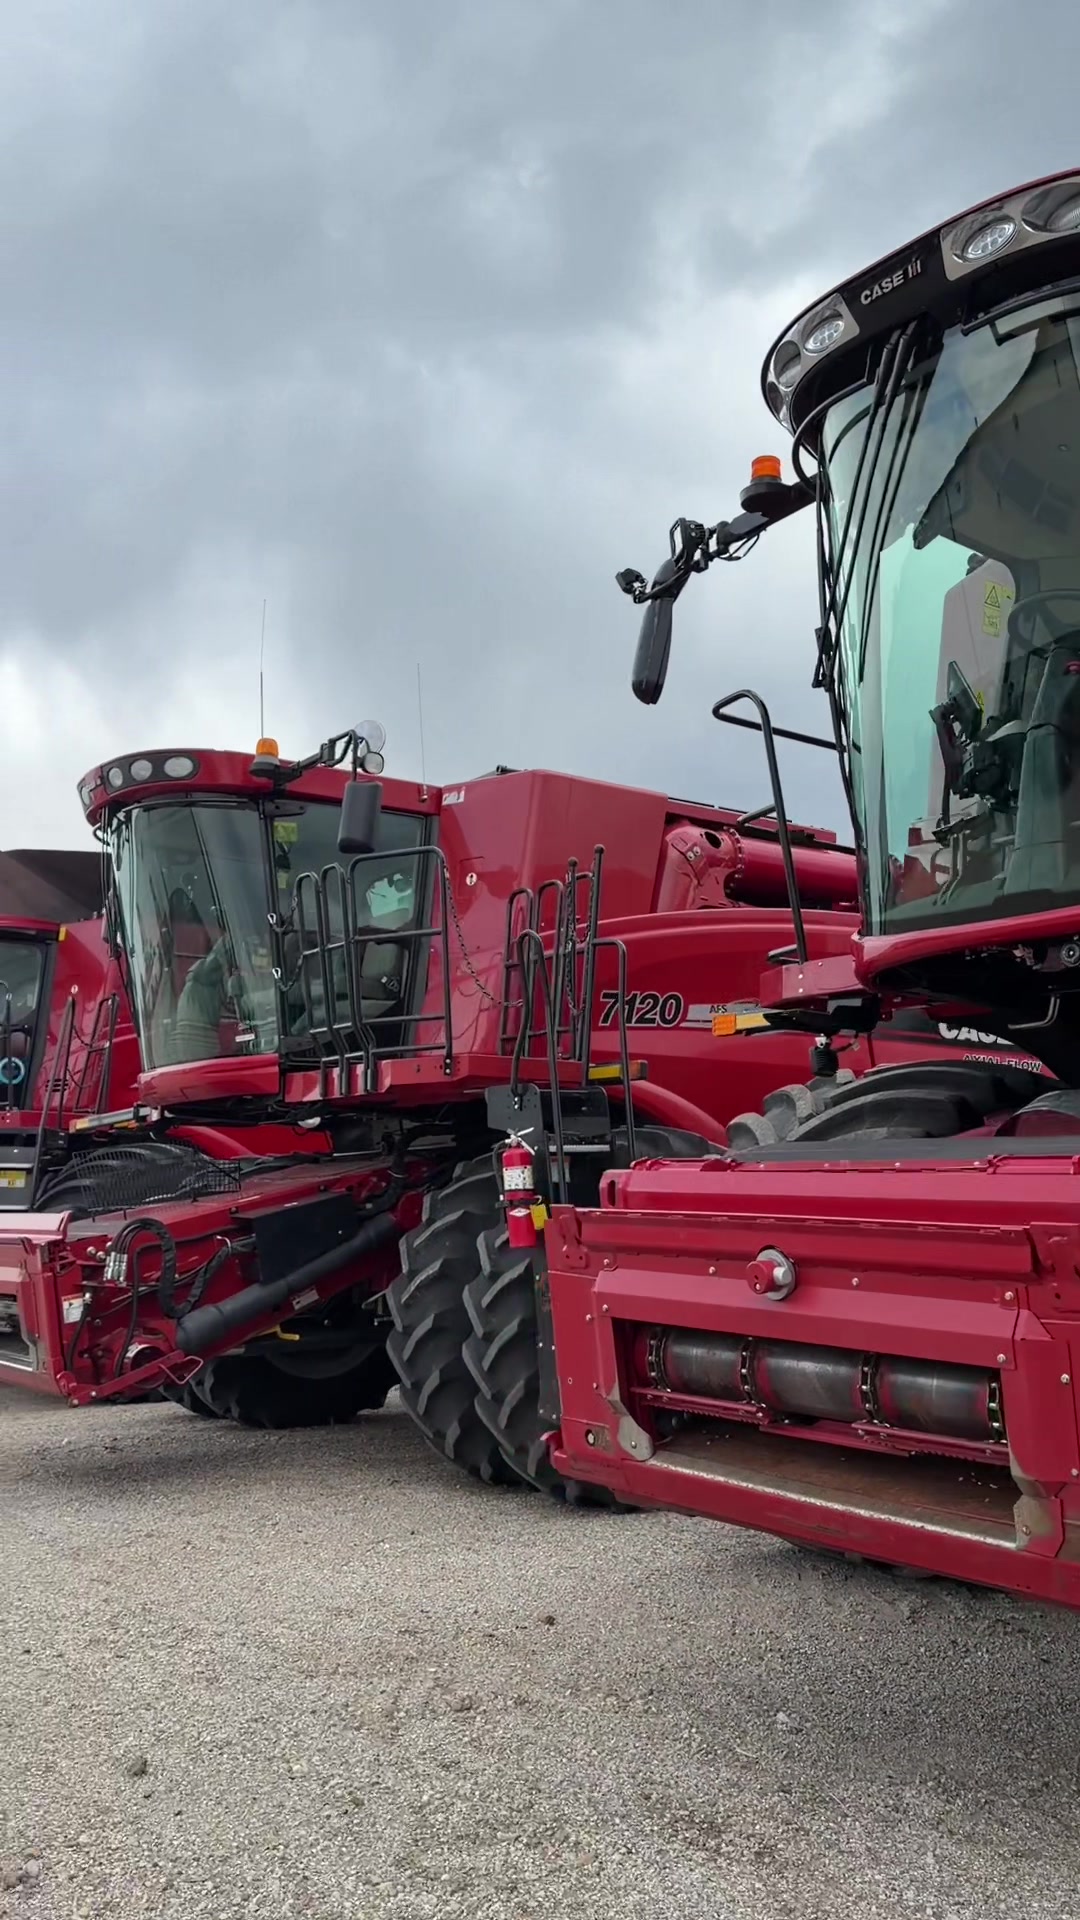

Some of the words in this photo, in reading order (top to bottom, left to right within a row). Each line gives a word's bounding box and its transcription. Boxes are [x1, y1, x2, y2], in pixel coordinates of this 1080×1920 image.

[860, 270, 904, 305] CASE
[599, 990, 684, 1028] 7120
[709, 1004, 728, 1014] AFS
